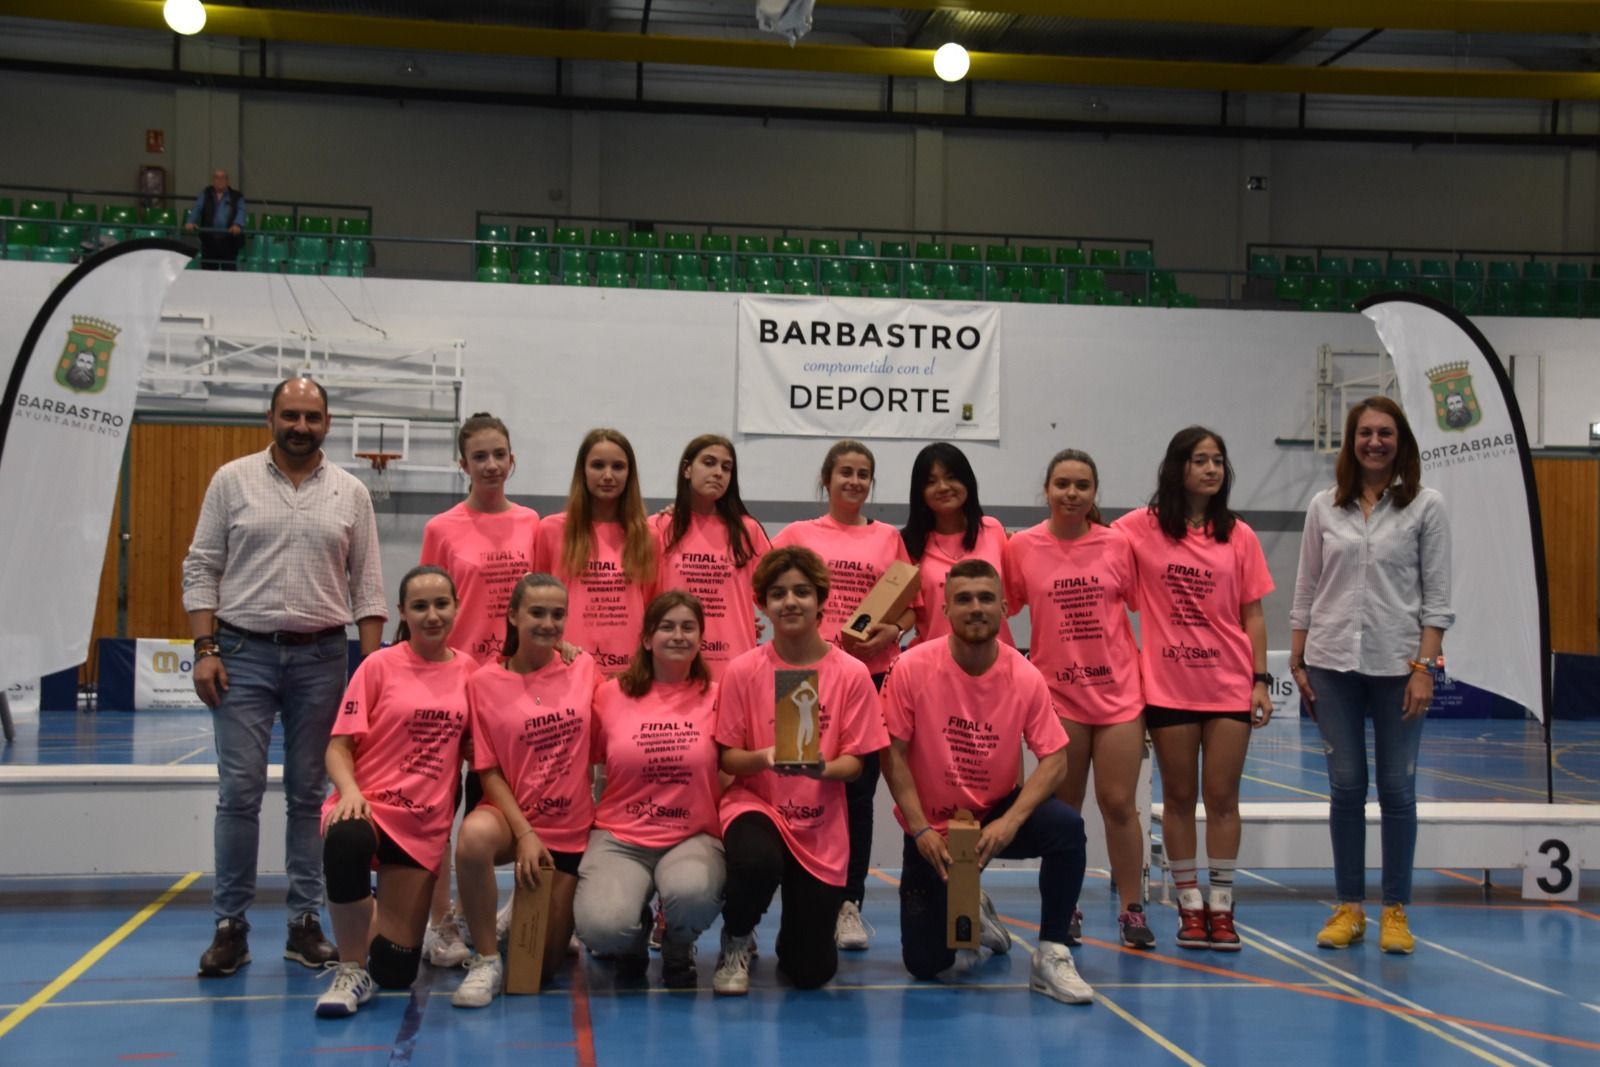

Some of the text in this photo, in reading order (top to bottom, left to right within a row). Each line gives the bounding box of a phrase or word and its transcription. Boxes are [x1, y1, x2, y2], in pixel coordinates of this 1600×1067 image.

[759, 318, 981, 350] BARBASTRO
[803, 354, 936, 377] comprometido con el
[790, 384, 950, 413] DEPORTE
[18, 393, 124, 428] BARBASTRO
[15, 409, 121, 438] AYUNTAMIENTO
[681, 553, 718, 563] FINAL
[827, 560, 874, 573] FINAL 4
[1167, 564, 1213, 579] FINAL 4
[1053, 575, 1099, 590] FINAL 4
[1162, 647, 1221, 660] La Salle
[1056, 665, 1113, 682] La Salle
[414, 709, 464, 722] FINAL 4
[524, 708, 576, 731] FINAL 4
[640, 721, 693, 732] FINAL 4
[948, 715, 993, 734] FINAL 4
[648, 755, 684, 765] LA SALLE
[626, 802, 691, 820] La Salle
[1536, 838, 1573, 895] 3
